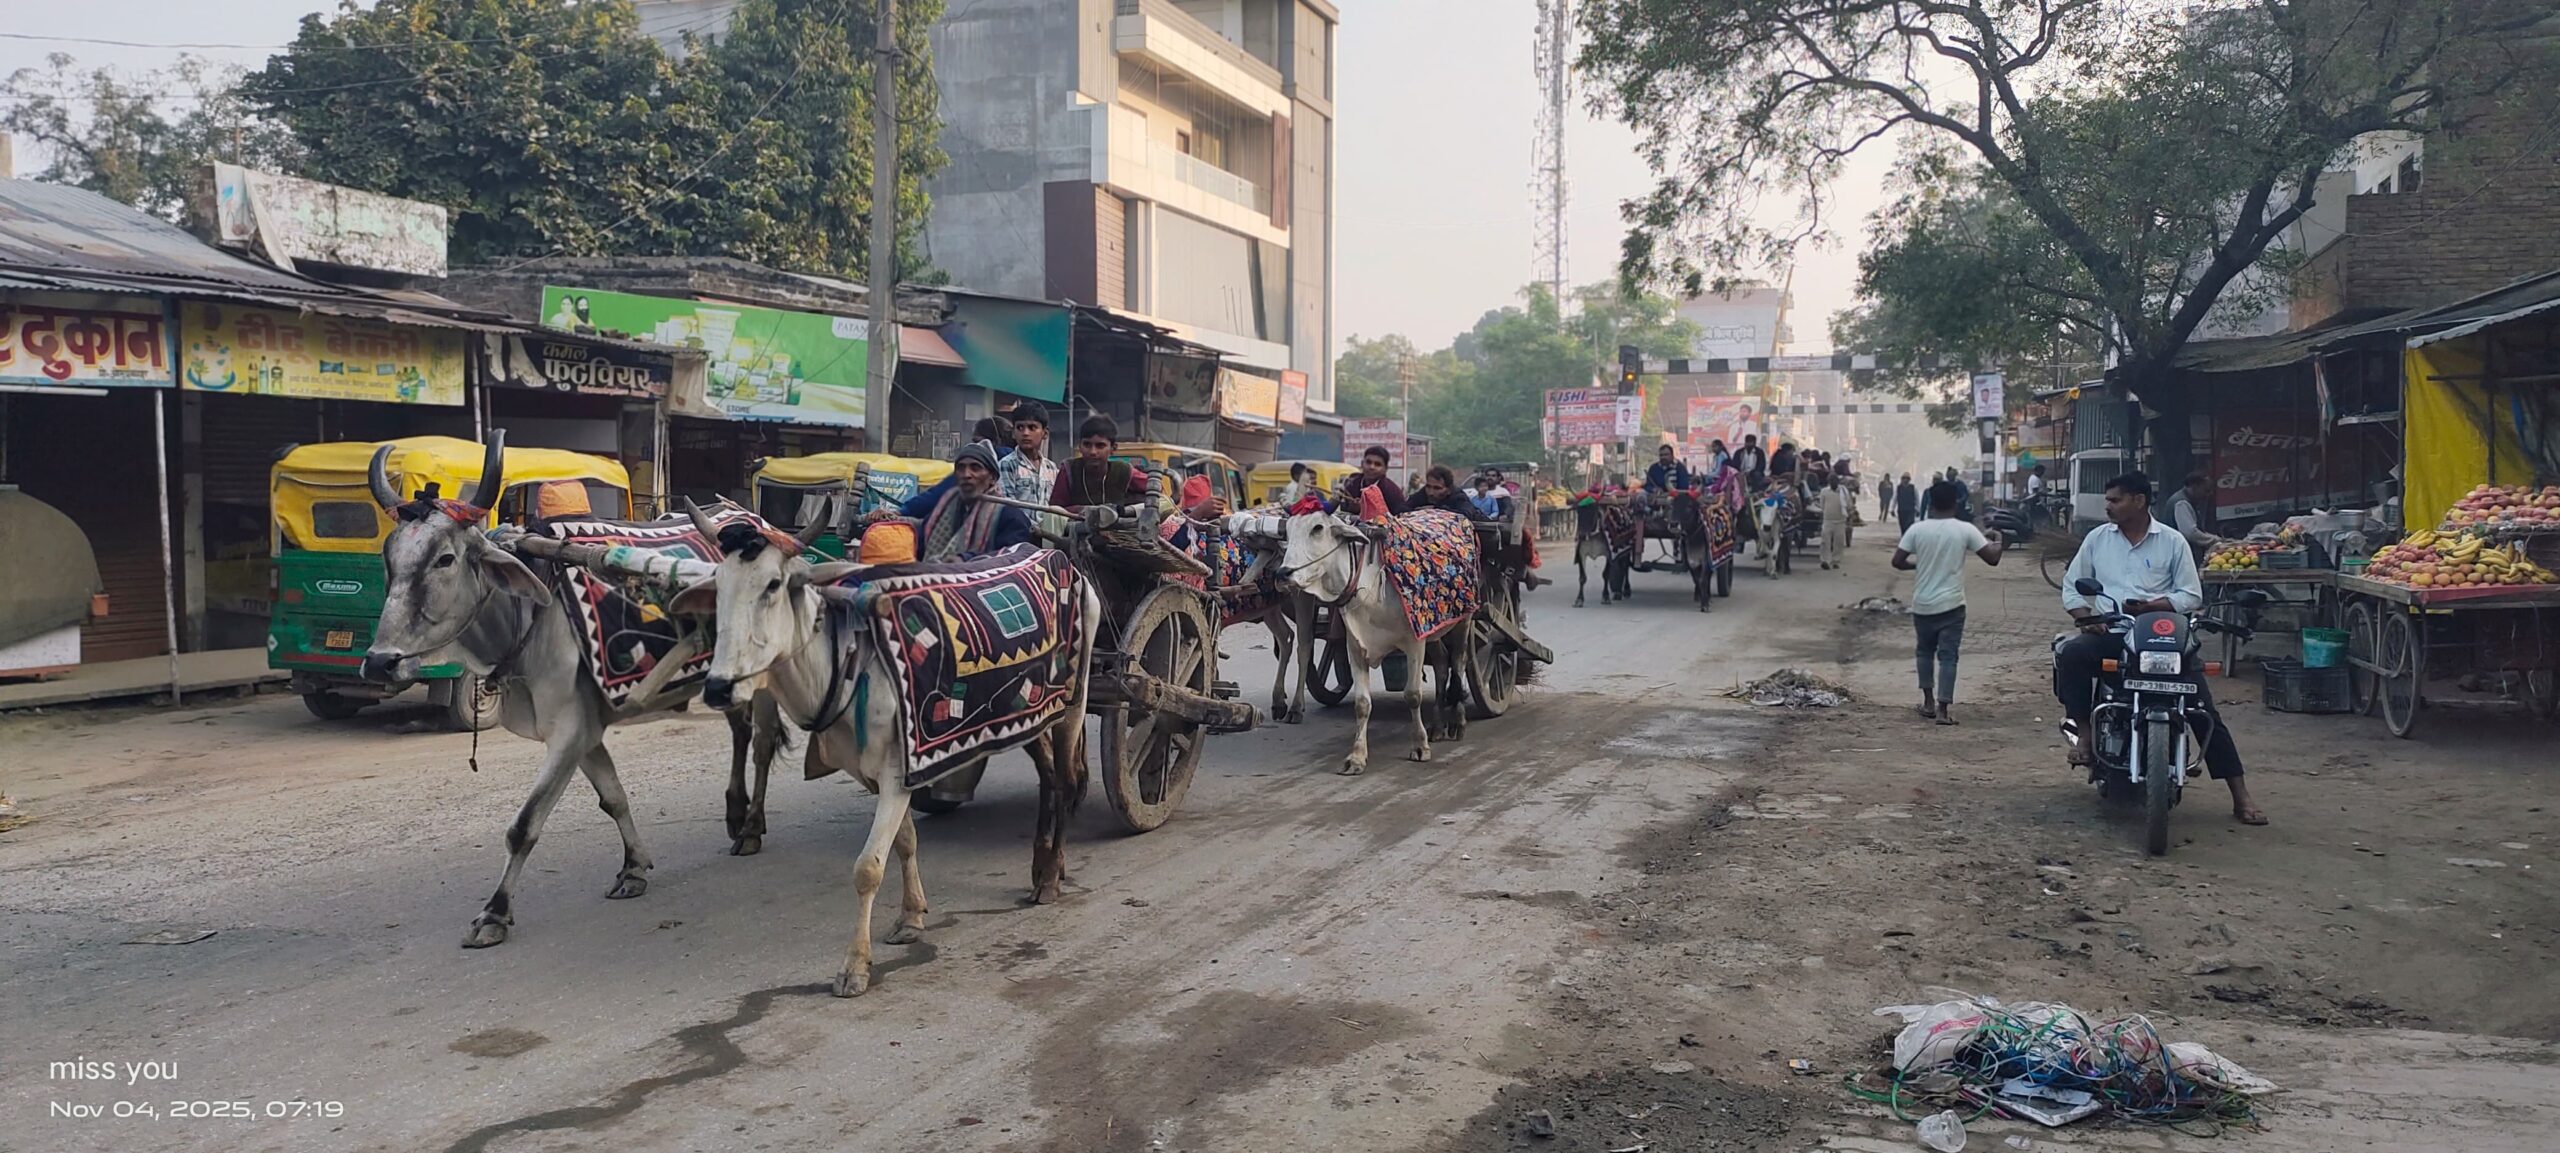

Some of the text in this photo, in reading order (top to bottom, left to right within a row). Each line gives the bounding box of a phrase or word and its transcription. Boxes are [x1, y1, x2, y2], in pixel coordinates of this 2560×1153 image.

[19, 306, 163, 380] दुकान
[542, 341, 589, 361] कमल
[543, 356, 651, 391] फुटवियर
